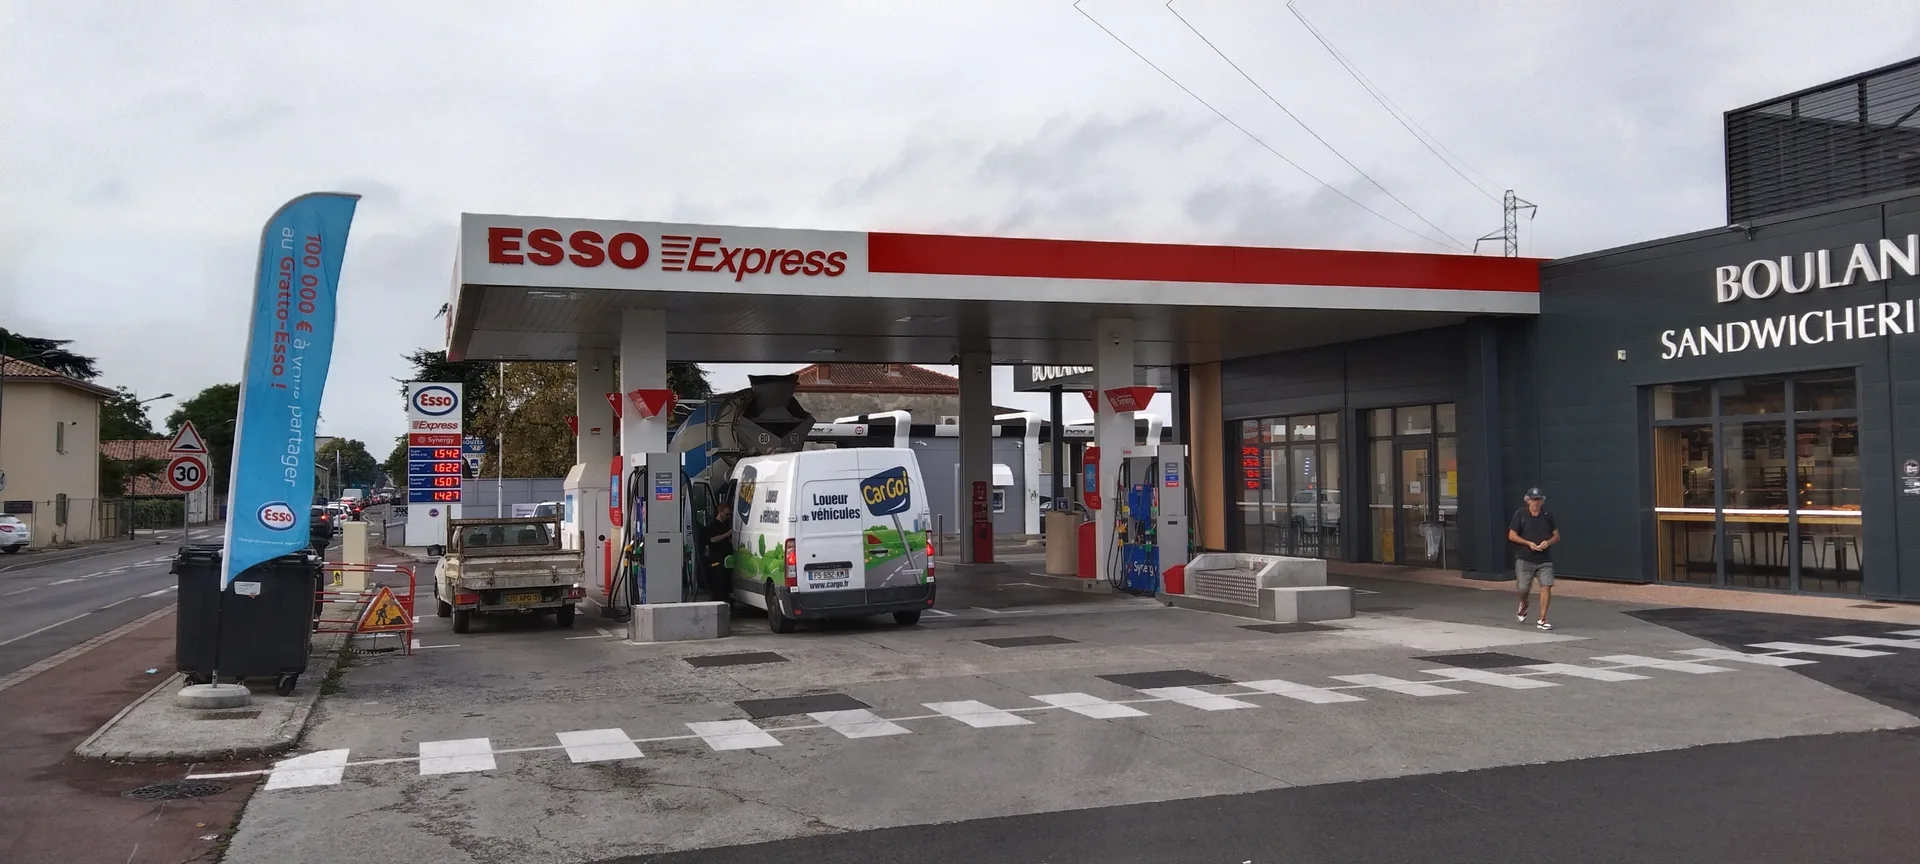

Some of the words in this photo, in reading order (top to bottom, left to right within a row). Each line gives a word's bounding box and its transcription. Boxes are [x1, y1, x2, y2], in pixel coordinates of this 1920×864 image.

[281, 227, 295, 250] au
[303, 233, 323, 269] 100
[488, 226, 650, 270] ESSO
[687, 236, 849, 283] Express
[1716, 234, 1920, 304] BOULAN
[298, 274, 319, 315] 000
[272, 256, 295, 377] Gratto-Esso
[295, 320, 313, 333] €
[1661, 299, 1920, 360] SANDWICHERI
[293, 338, 311, 350] à
[420, 393, 452, 407] Esso
[608, 393, 616, 402] 4
[672, 394, 679, 402] 3
[418, 420, 459, 431] Express
[281, 405, 304, 488] partager
[427, 436, 455, 445] Synergy
[433, 449, 459, 459] 1.542
[175, 465, 200, 482] 30
[433, 463, 459, 473] 1.622
[434, 477, 459, 487] 1.507
[433, 491, 459, 501] 1.427
[813, 493, 849, 506] Loueur
[264, 508, 292, 523] Esso
[801, 514, 810, 522] de
[811, 506, 861, 521] véhicules
[809, 580, 849, 590] www.cargo.fr
